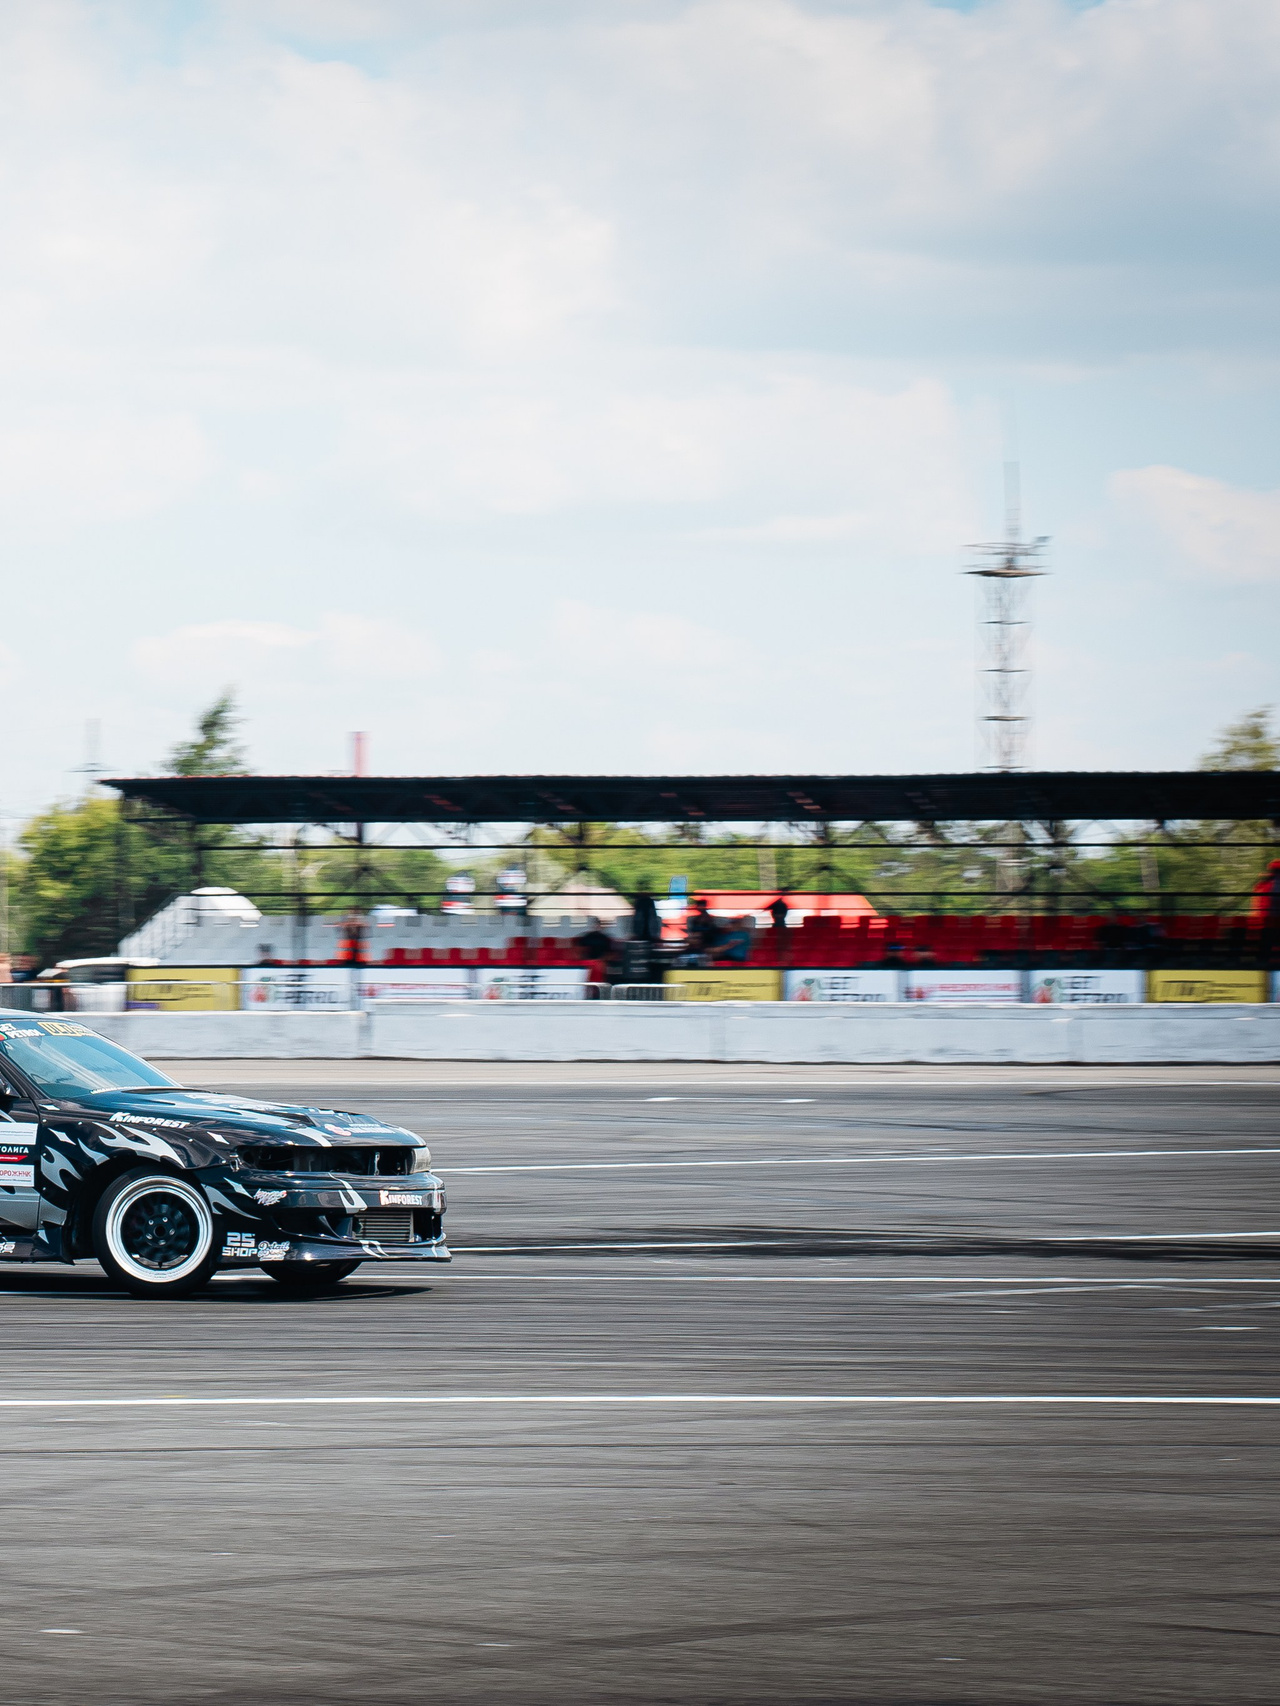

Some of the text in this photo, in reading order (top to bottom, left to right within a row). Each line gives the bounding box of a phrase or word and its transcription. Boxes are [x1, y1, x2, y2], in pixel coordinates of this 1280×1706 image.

[109, 1111, 190, 1129] KINFOREST
[379, 1190, 423, 1206] KINFOREST
[222, 1246, 258, 1257] SHOP
